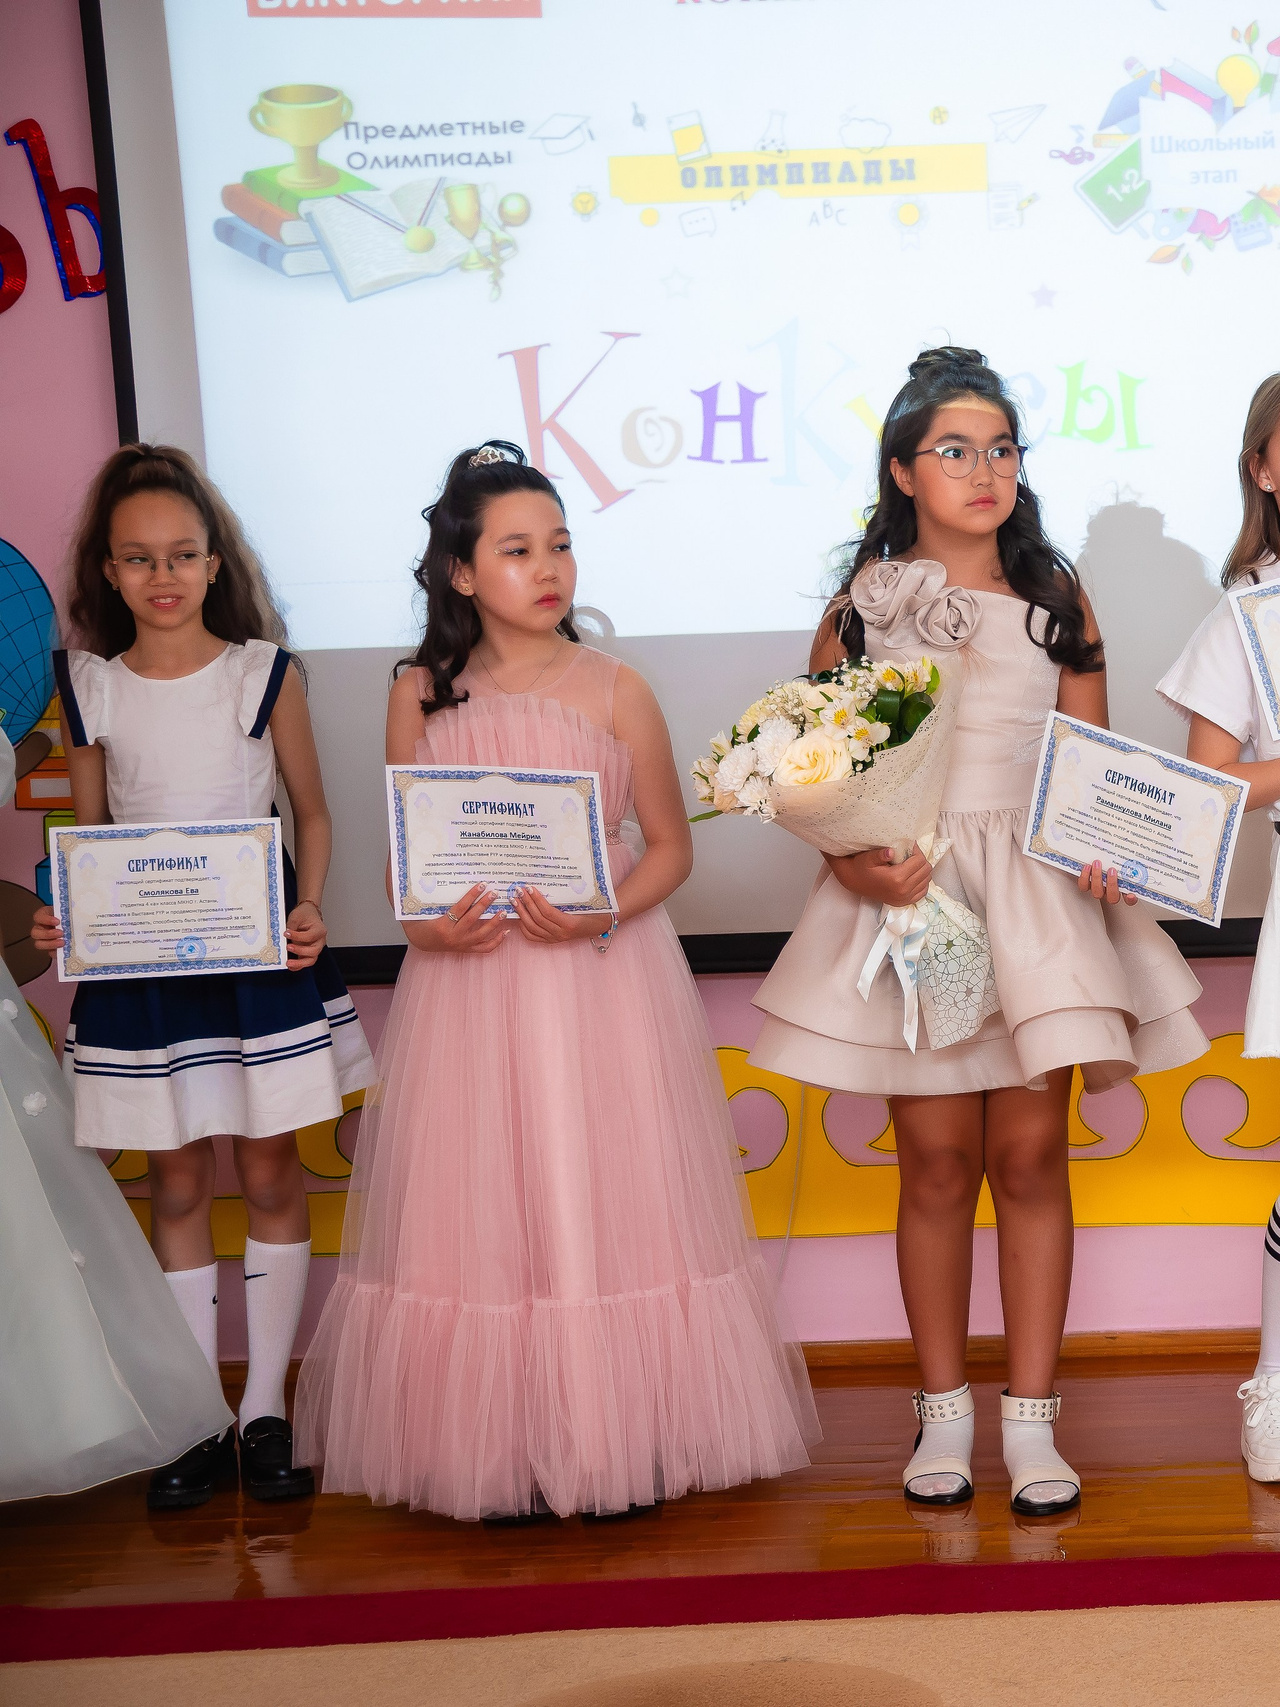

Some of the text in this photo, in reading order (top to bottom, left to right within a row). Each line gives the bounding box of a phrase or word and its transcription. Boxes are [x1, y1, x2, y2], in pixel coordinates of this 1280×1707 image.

[343, 119, 526, 144] Предметные
[1150, 130, 1276, 154] Школьный
[346, 150, 513, 171] Олимпиады
[680, 158, 916, 189] ОЛИМПИАДЫ
[1189, 168, 1238, 185] этап
[1105, 769, 1175, 806] СЕРТИФИКАТ
[461, 800, 536, 818] СЕРТИФИКАТ
[1095, 795, 1172, 830] Раманкулова Милана
[459, 830, 541, 840] Жанабилова Мейрим
[127, 855, 208, 873] СЕРТИФИКАТ
[138, 886, 199, 897] Смолякова Ева
